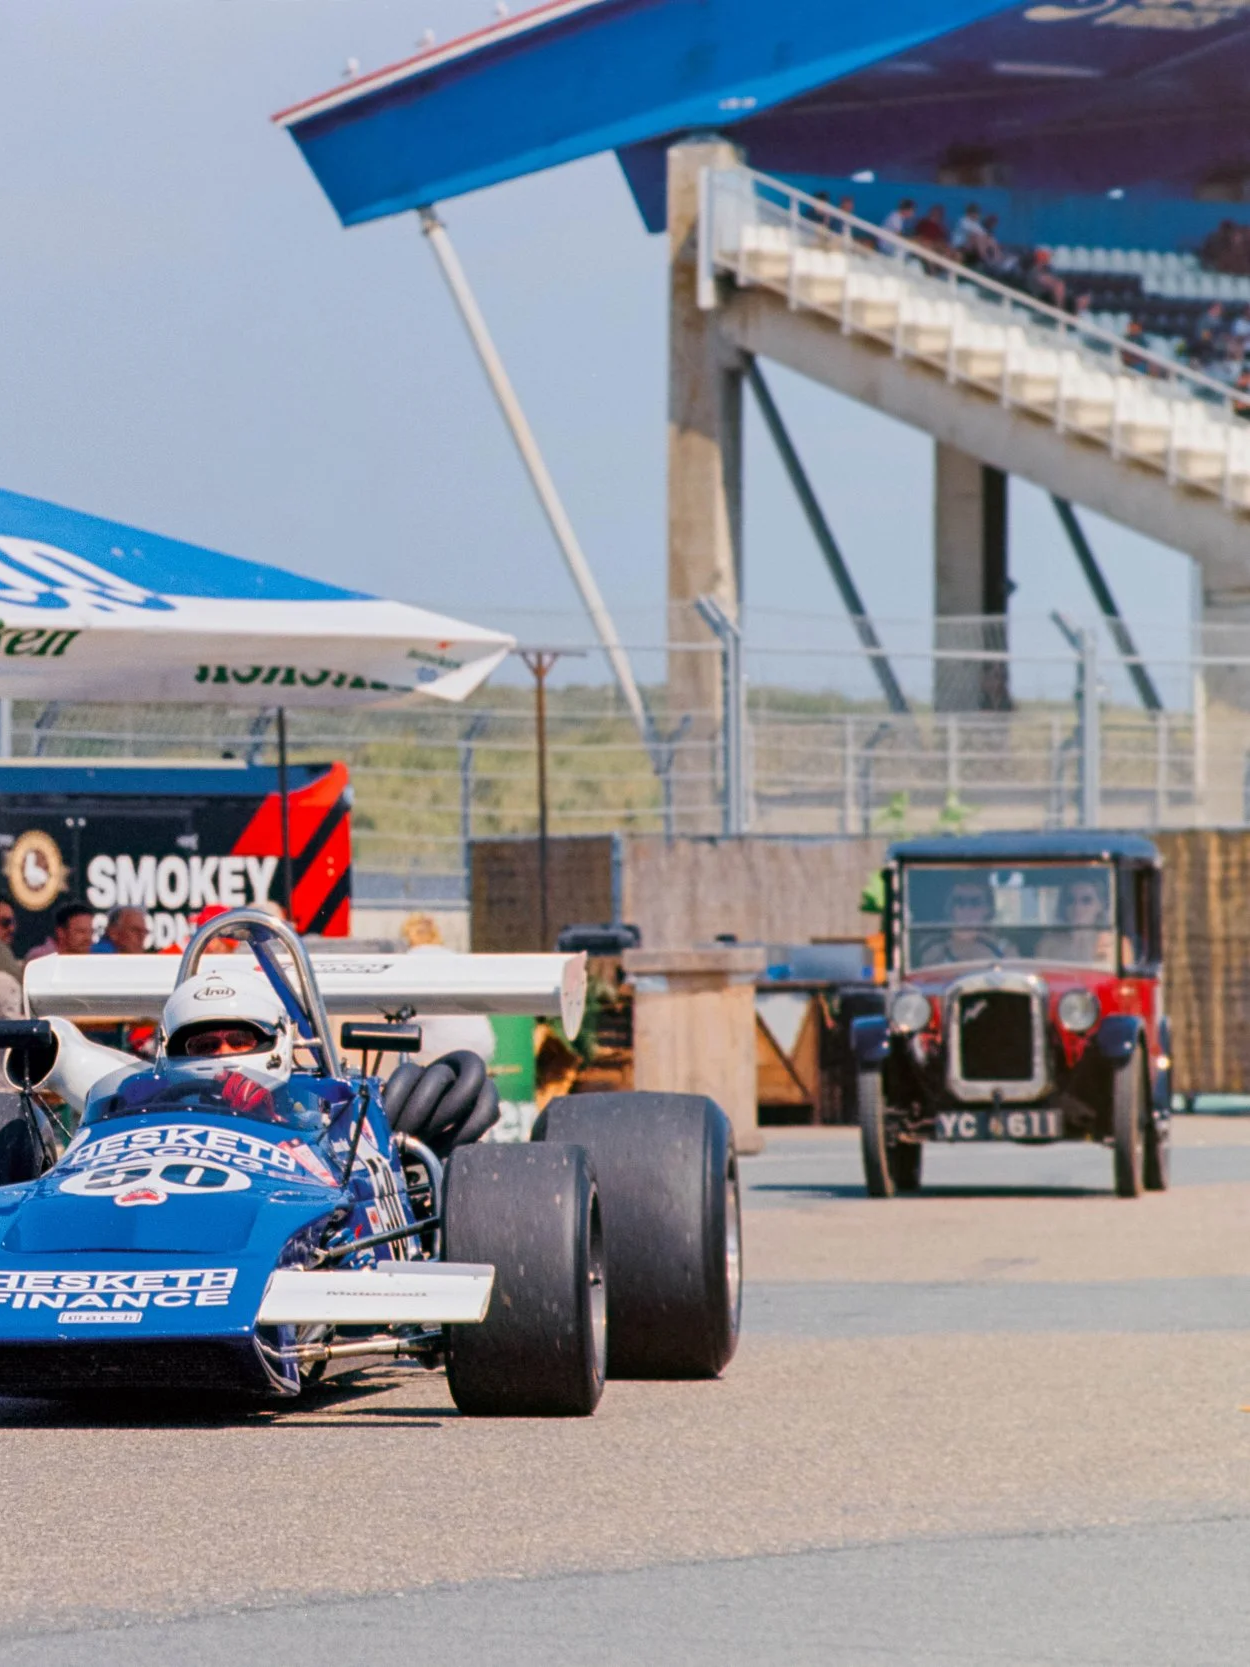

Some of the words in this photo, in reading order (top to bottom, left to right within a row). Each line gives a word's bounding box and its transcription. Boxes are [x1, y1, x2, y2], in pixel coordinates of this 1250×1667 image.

[87, 855, 279, 908] SMOKEY
[939, 1112, 976, 1137] YC
[71, 1126, 297, 1172] HESKETH
[90, 1149, 264, 1170] RACING
[84, 1163, 230, 1190] 50
